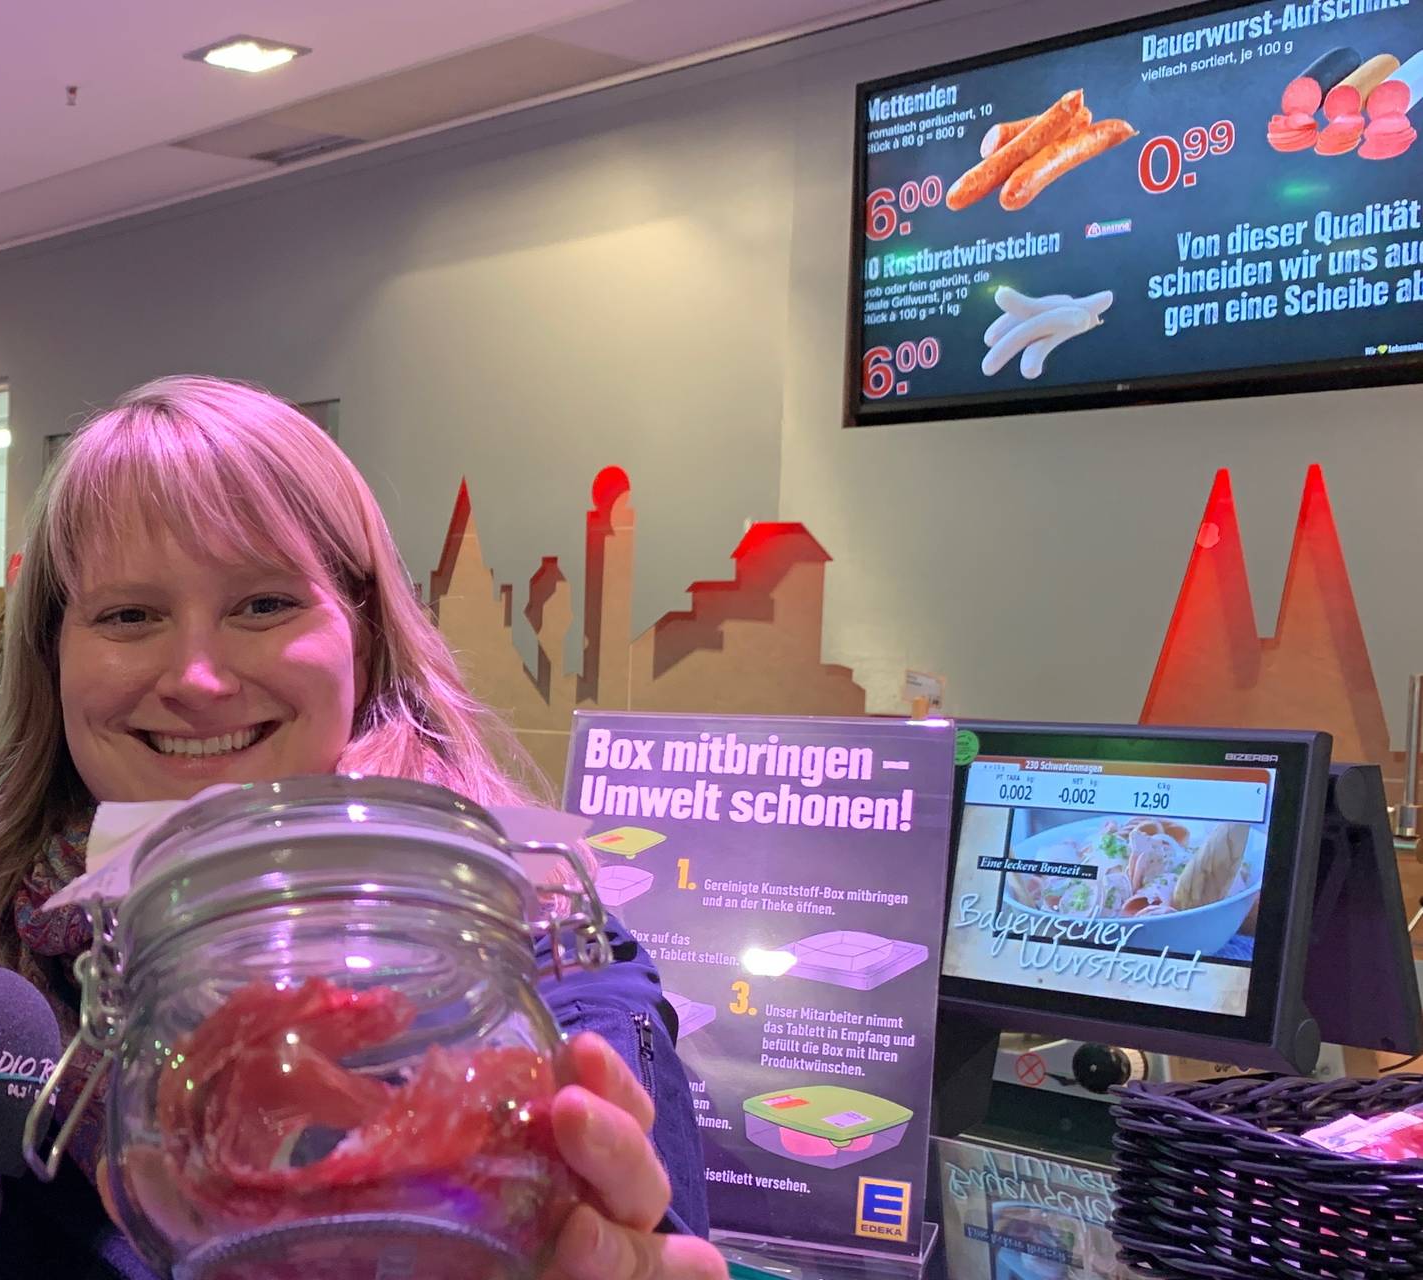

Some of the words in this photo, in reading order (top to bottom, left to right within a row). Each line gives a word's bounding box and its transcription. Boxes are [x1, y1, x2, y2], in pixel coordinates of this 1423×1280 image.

[1141, 63, 1187, 82] vielfach
[1190, 54, 1237, 72] sortiert,
[1239, 49, 1253, 65] je
[1257, 41, 1281, 58] 100
[1284, 40, 1294, 54] g
[919, 110, 976, 131] geräuchert,
[980, 104, 993, 117] 10
[902, 134, 915, 148] 80
[917, 135, 924, 146] g
[936, 127, 955, 141] 800
[958, 125, 965, 138] g
[1176, 231, 1220, 262] Von
[1227, 220, 1308, 256] dieser
[1314, 199, 1422, 246] Qualität
[883, 232, 1061, 279] Rostbratwürstchen
[884, 282, 906, 296] oder
[909, 278, 927, 292] fein
[929, 272, 972, 291] gebrüht,
[974, 270, 990, 284] die
[1148, 258, 1272, 299] schneiden
[1279, 249, 1322, 282] wir
[1328, 246, 1378, 277] uns
[892, 291, 940, 309] Grillwurst,
[942, 290, 952, 304] je
[955, 287, 968, 299] 10
[1164, 299, 1219, 337] gern
[1226, 291, 1277, 323] eine
[1284, 277, 1389, 317] Scheibe
[899, 308, 917, 321] 100
[919, 308, 927, 320] g
[938, 303, 944, 315] 1
[947, 302, 960, 316] kg
[584, 728, 656, 771] Box
[662, 733, 873, 787] mitbringen
[1025, 760, 1039, 770] 230
[1040, 761, 1103, 774] Schwartenmagen
[1225, 753, 1278, 762] BIZERBA
[579, 774, 722, 821] Umwelt
[729, 784, 913, 832] schonen!
[1133, 792, 1170, 810] 12,90
[979, 857, 1003, 869] Eine
[1004, 858, 1038, 872] leckere
[1040, 861, 1081, 876] Brotzeit
[677, 858, 697, 891] 1.
[704, 879, 759, 895] Gereinigte
[761, 883, 845, 900] Kunststoff-Box
[847, 889, 908, 906] mitbringen
[702, 896, 722, 907] und
[724, 899, 738, 908] an
[740, 898, 758, 909] der
[761, 898, 794, 912] Theke
[796, 901, 835, 915] öffnen.
[954, 893, 1144, 957] Bayerischer
[651, 932, 669, 944] auf
[671, 933, 690, 945] das
[660, 948, 696, 962] Tablett
[698, 952, 740, 966] stellen.
[1020, 934, 1208, 990] Wurstsalat
[729, 980, 757, 1015] 3.
[765, 1004, 798, 1018] Unser
[800, 1007, 863, 1025] Mitarbeiter
[865, 1014, 903, 1029] nimmt
[763, 1021, 783, 1034] das
[786, 1022, 825, 1038] Tablett
[827, 1027, 838, 1039] in
[841, 1028, 890, 1047] Empfang
[893, 1034, 915, 1047] und
[762, 1037, 800, 1053] befüllt
[802, 1041, 819, 1054] die
[822, 1043, 843, 1057] Box
[846, 1045, 866, 1059] mit
[868, 1047, 898, 1062] Ihren
[39, 1058, 56, 1084] R
[760, 1054, 866, 1077] Produktwünschen.
[696, 1113, 732, 1130] hmen.
[704, 1168, 753, 1186] isetikett
[755, 1176, 811, 1194] versehen.
[861, 1223, 902, 1237] EDEKA
